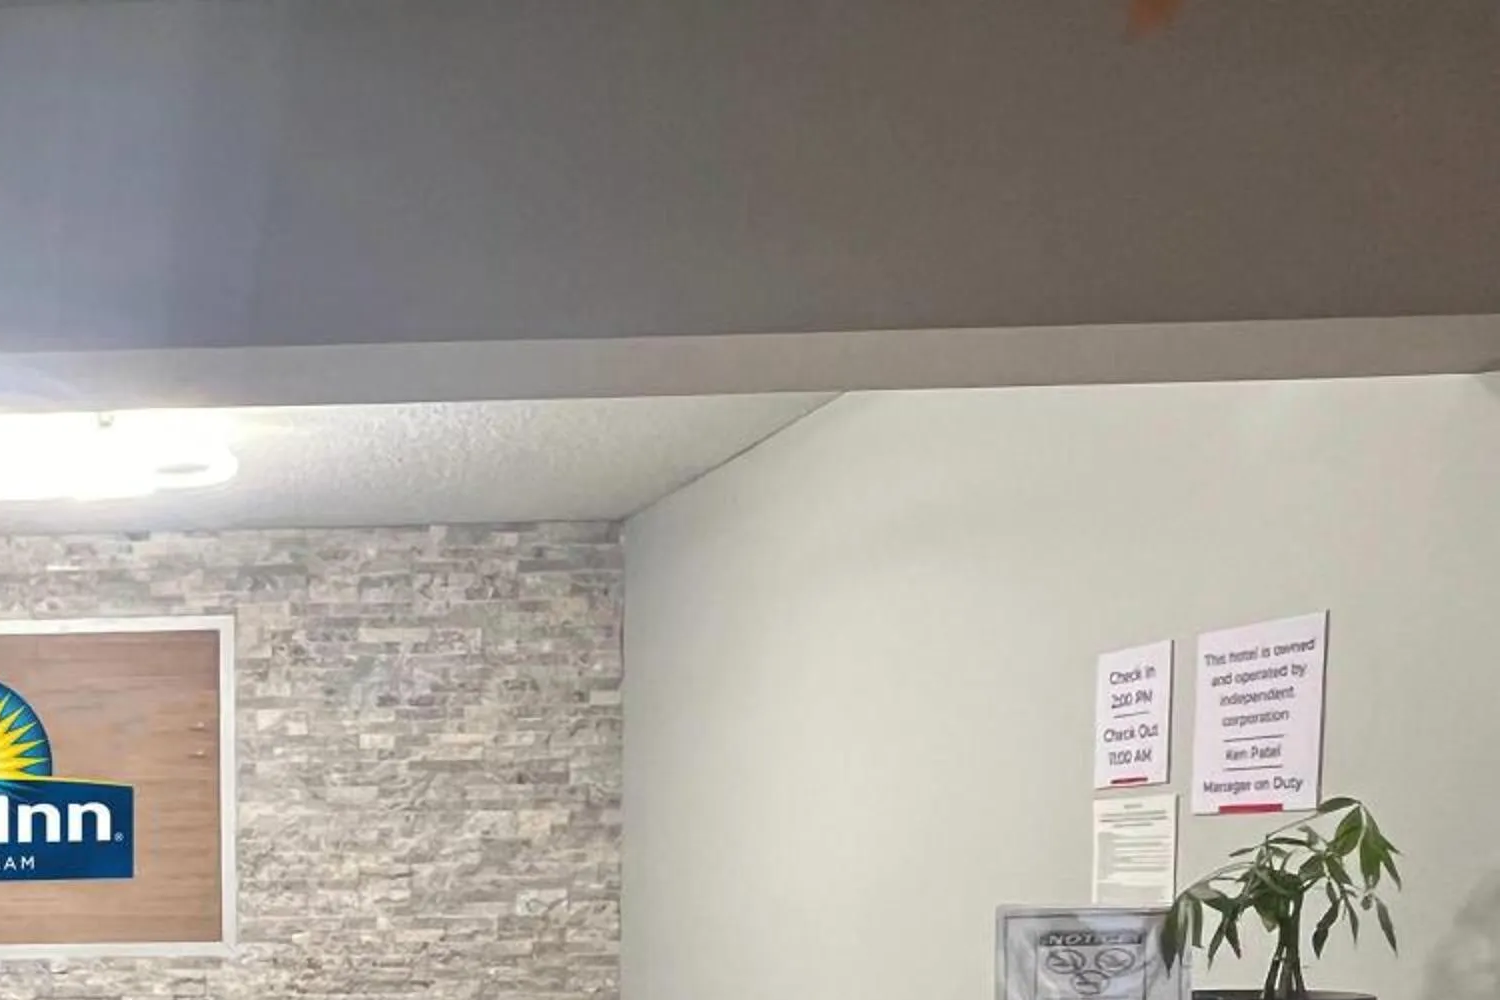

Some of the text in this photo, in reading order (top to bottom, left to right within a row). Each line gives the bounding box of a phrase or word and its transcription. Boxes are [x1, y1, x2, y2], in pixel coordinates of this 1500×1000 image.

[1110, 669, 1142, 685] Check
[1234, 665, 1288, 685] operated
[1291, 663, 1307, 678] by
[1219, 686, 1295, 706] independent
[1222, 709, 1290, 728] corporation
[1104, 723, 1159, 743] Check Out
[1203, 780, 1252, 795] Manager
[1273, 776, 1304, 793] Duty
